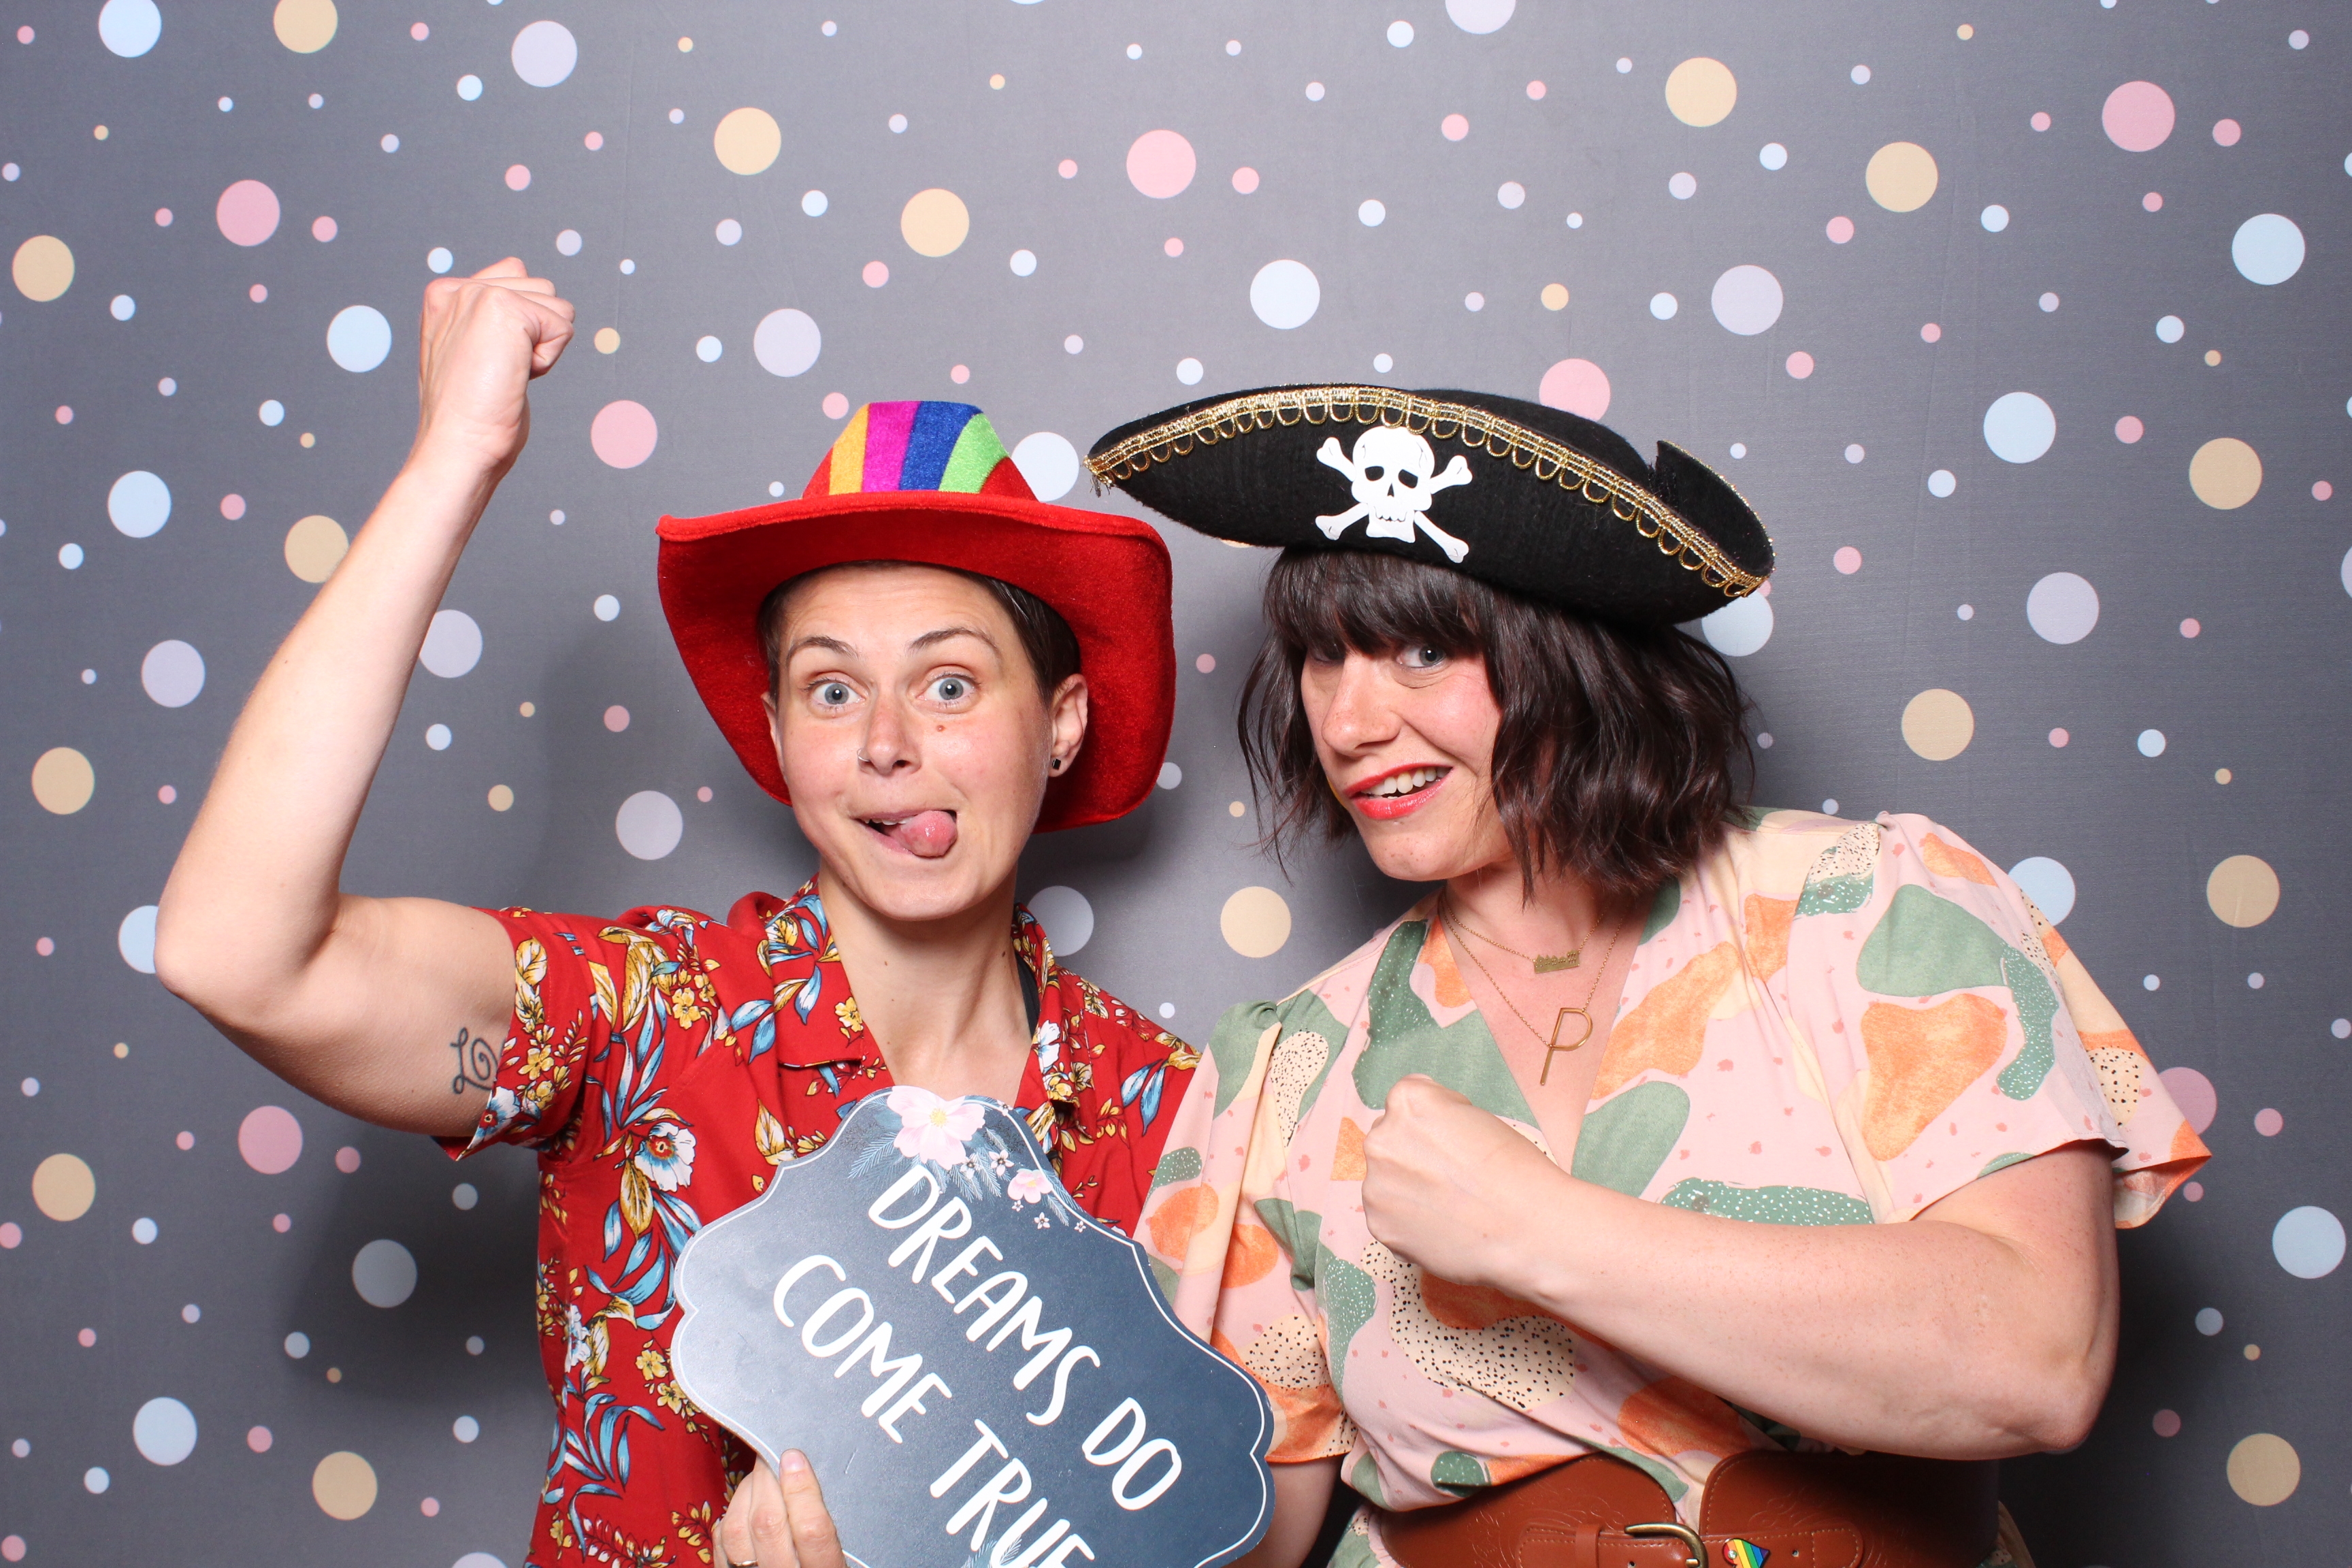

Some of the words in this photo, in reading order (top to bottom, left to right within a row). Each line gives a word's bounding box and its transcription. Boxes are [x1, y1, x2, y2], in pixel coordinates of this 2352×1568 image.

[772, 1254, 952, 1443] COME
[868, 1164, 1100, 1425] DREAMS
[1081, 1396, 1182, 1510] DO
